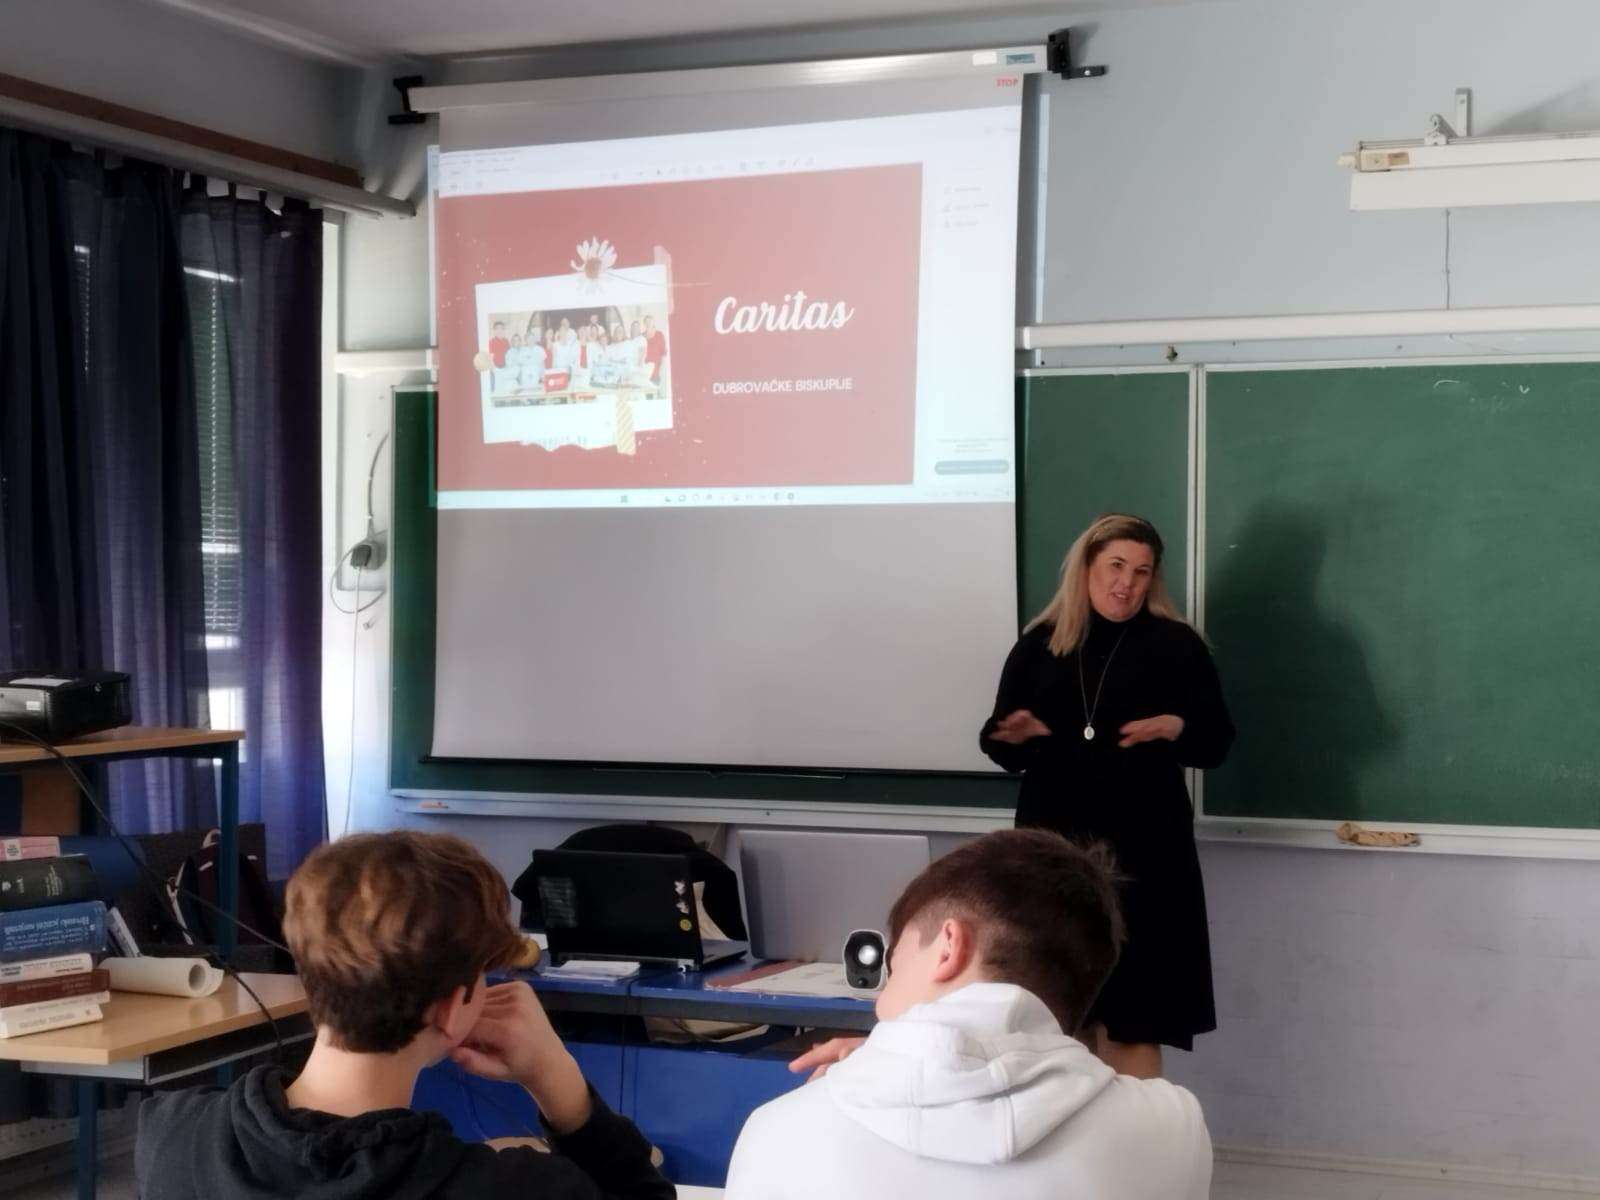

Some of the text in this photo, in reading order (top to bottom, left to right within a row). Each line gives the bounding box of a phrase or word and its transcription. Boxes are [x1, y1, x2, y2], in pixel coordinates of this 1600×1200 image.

[996, 78, 1018, 88] STOP
[714, 291, 855, 334] Caritas
[713, 377, 853, 394] DUBROVAČKE BISKUPIJE
